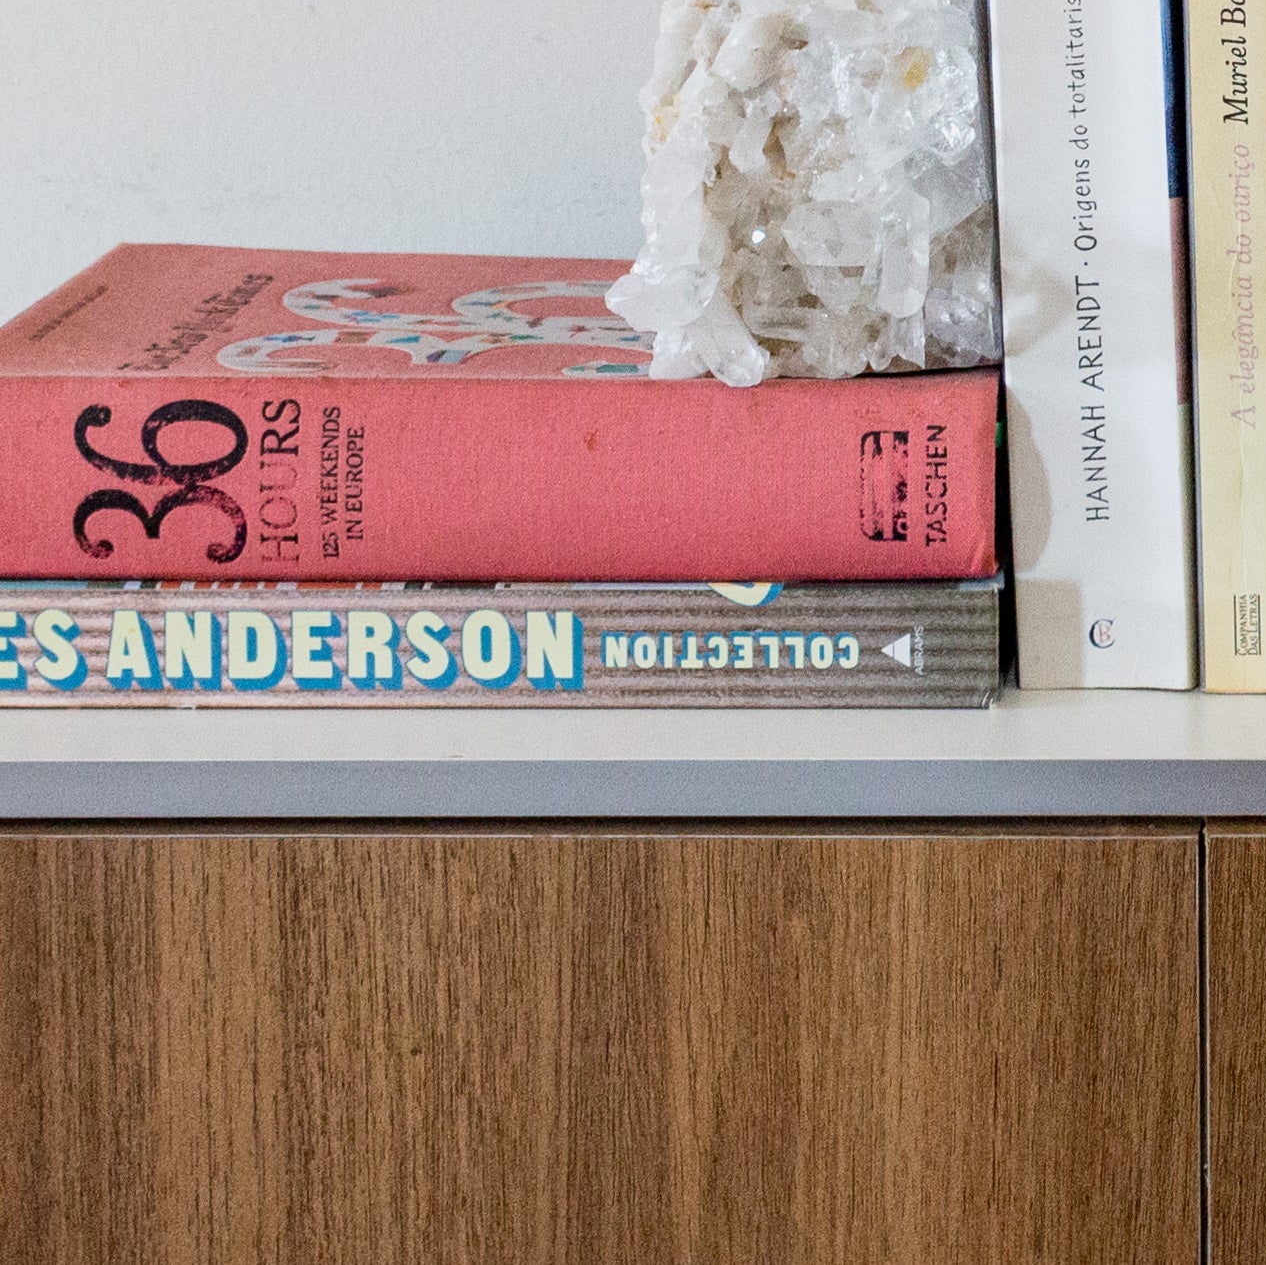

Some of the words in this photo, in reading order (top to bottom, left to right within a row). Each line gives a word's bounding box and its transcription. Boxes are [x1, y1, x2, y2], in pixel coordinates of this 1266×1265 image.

[1221, 36, 1249, 125] Muriel
[1068, 124, 1090, 150] do
[1073, 158, 1098, 252] Origens
[1229, 143, 1256, 223] ouriço
[1226, 234, 1253, 264] do
[1075, 275, 1105, 391] ARENDT
[1229, 275, 1260, 395] elegância
[1230, 405, 1256, 430] A
[73, 398, 250, 564] 36
[259, 398, 302, 563] HOURS
[319, 406, 342, 526] WEEKENDS
[346, 427, 366, 513] EUROPE
[924, 424, 950, 548] TASCHEN
[1080, 405, 1110, 522] HANNAH
[321, 531, 340, 560] 125
[346, 520, 364, 541] IN
[106, 609, 585, 691] ANDERSON
[601, 630, 860, 670] COLLECTION
